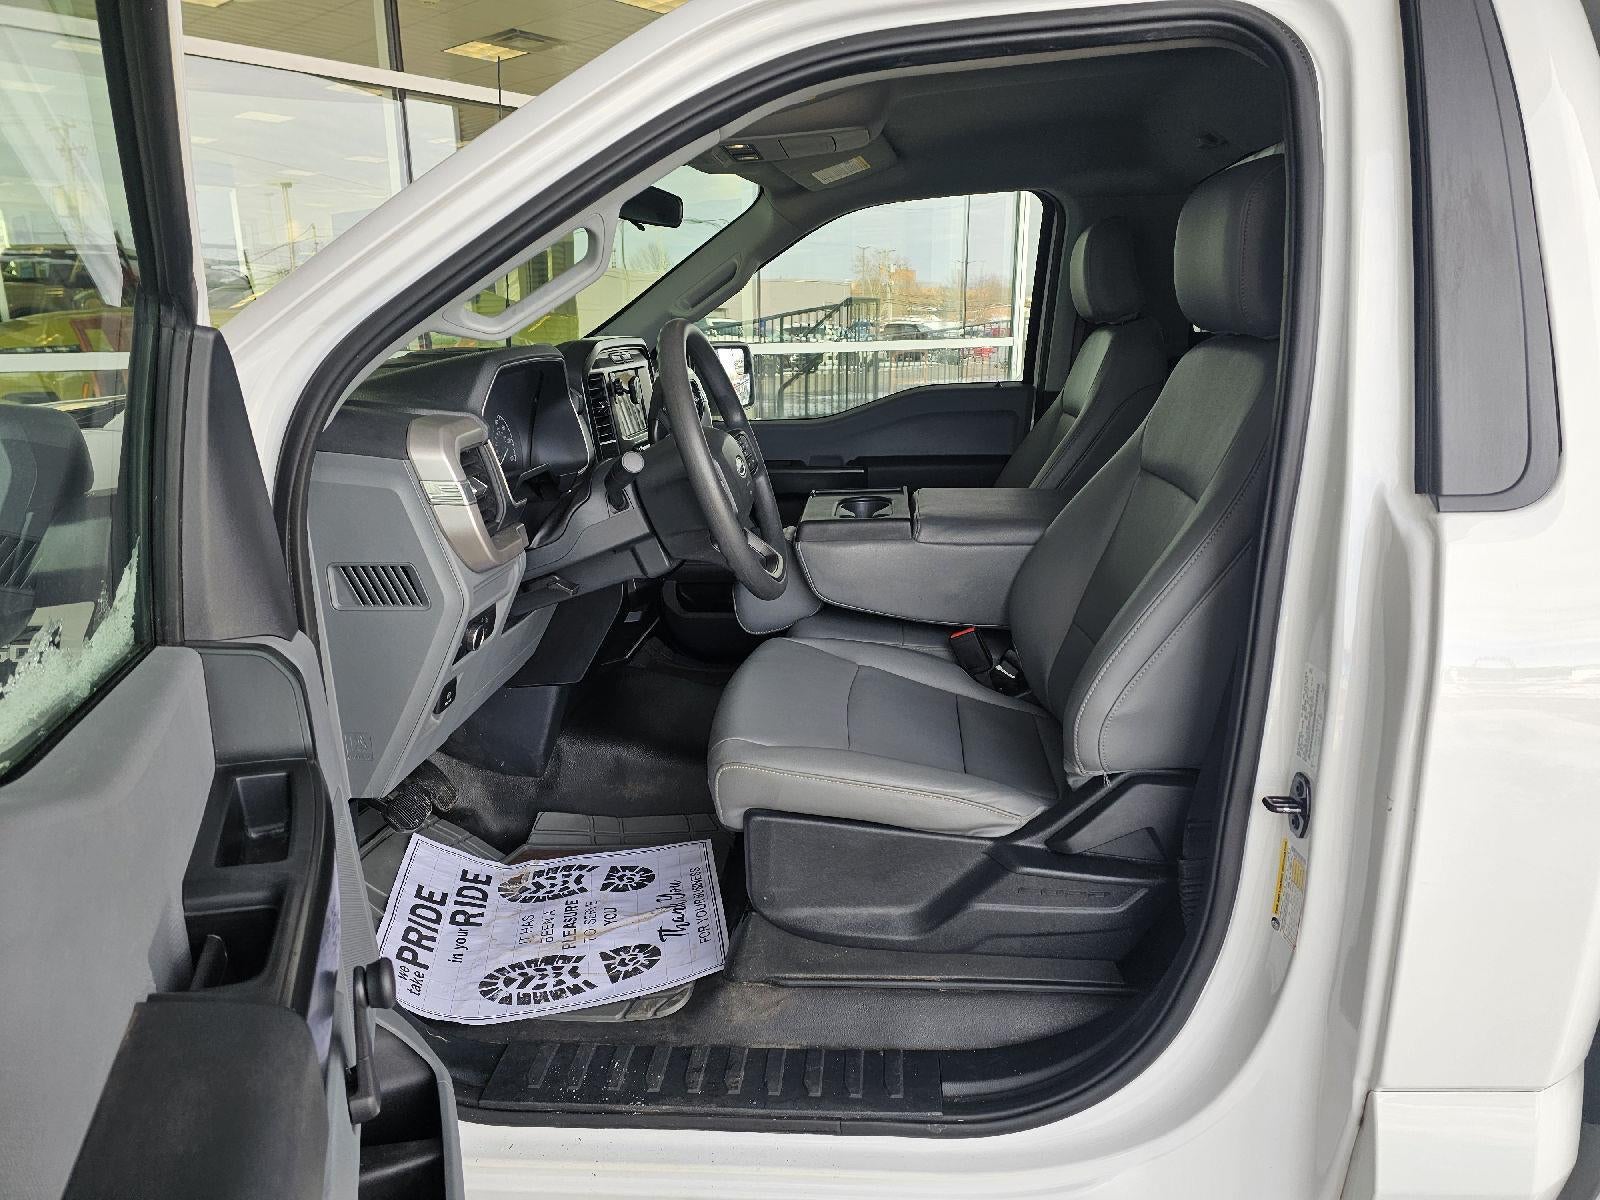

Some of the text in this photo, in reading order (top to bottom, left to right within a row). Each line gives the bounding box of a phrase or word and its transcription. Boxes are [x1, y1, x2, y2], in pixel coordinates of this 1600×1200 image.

[448, 869, 493, 963] in your RIDE
[519, 914, 535, 935] HAS
[561, 899, 579, 950] PLEASURE
[604, 907, 618, 927] YOU
[656, 880, 691, 943] Thank You
[689, 866, 712, 944] FOR YOUR BUSINESS
[396, 884, 449, 996] we take PRIDE
[584, 928, 597, 944] TO
